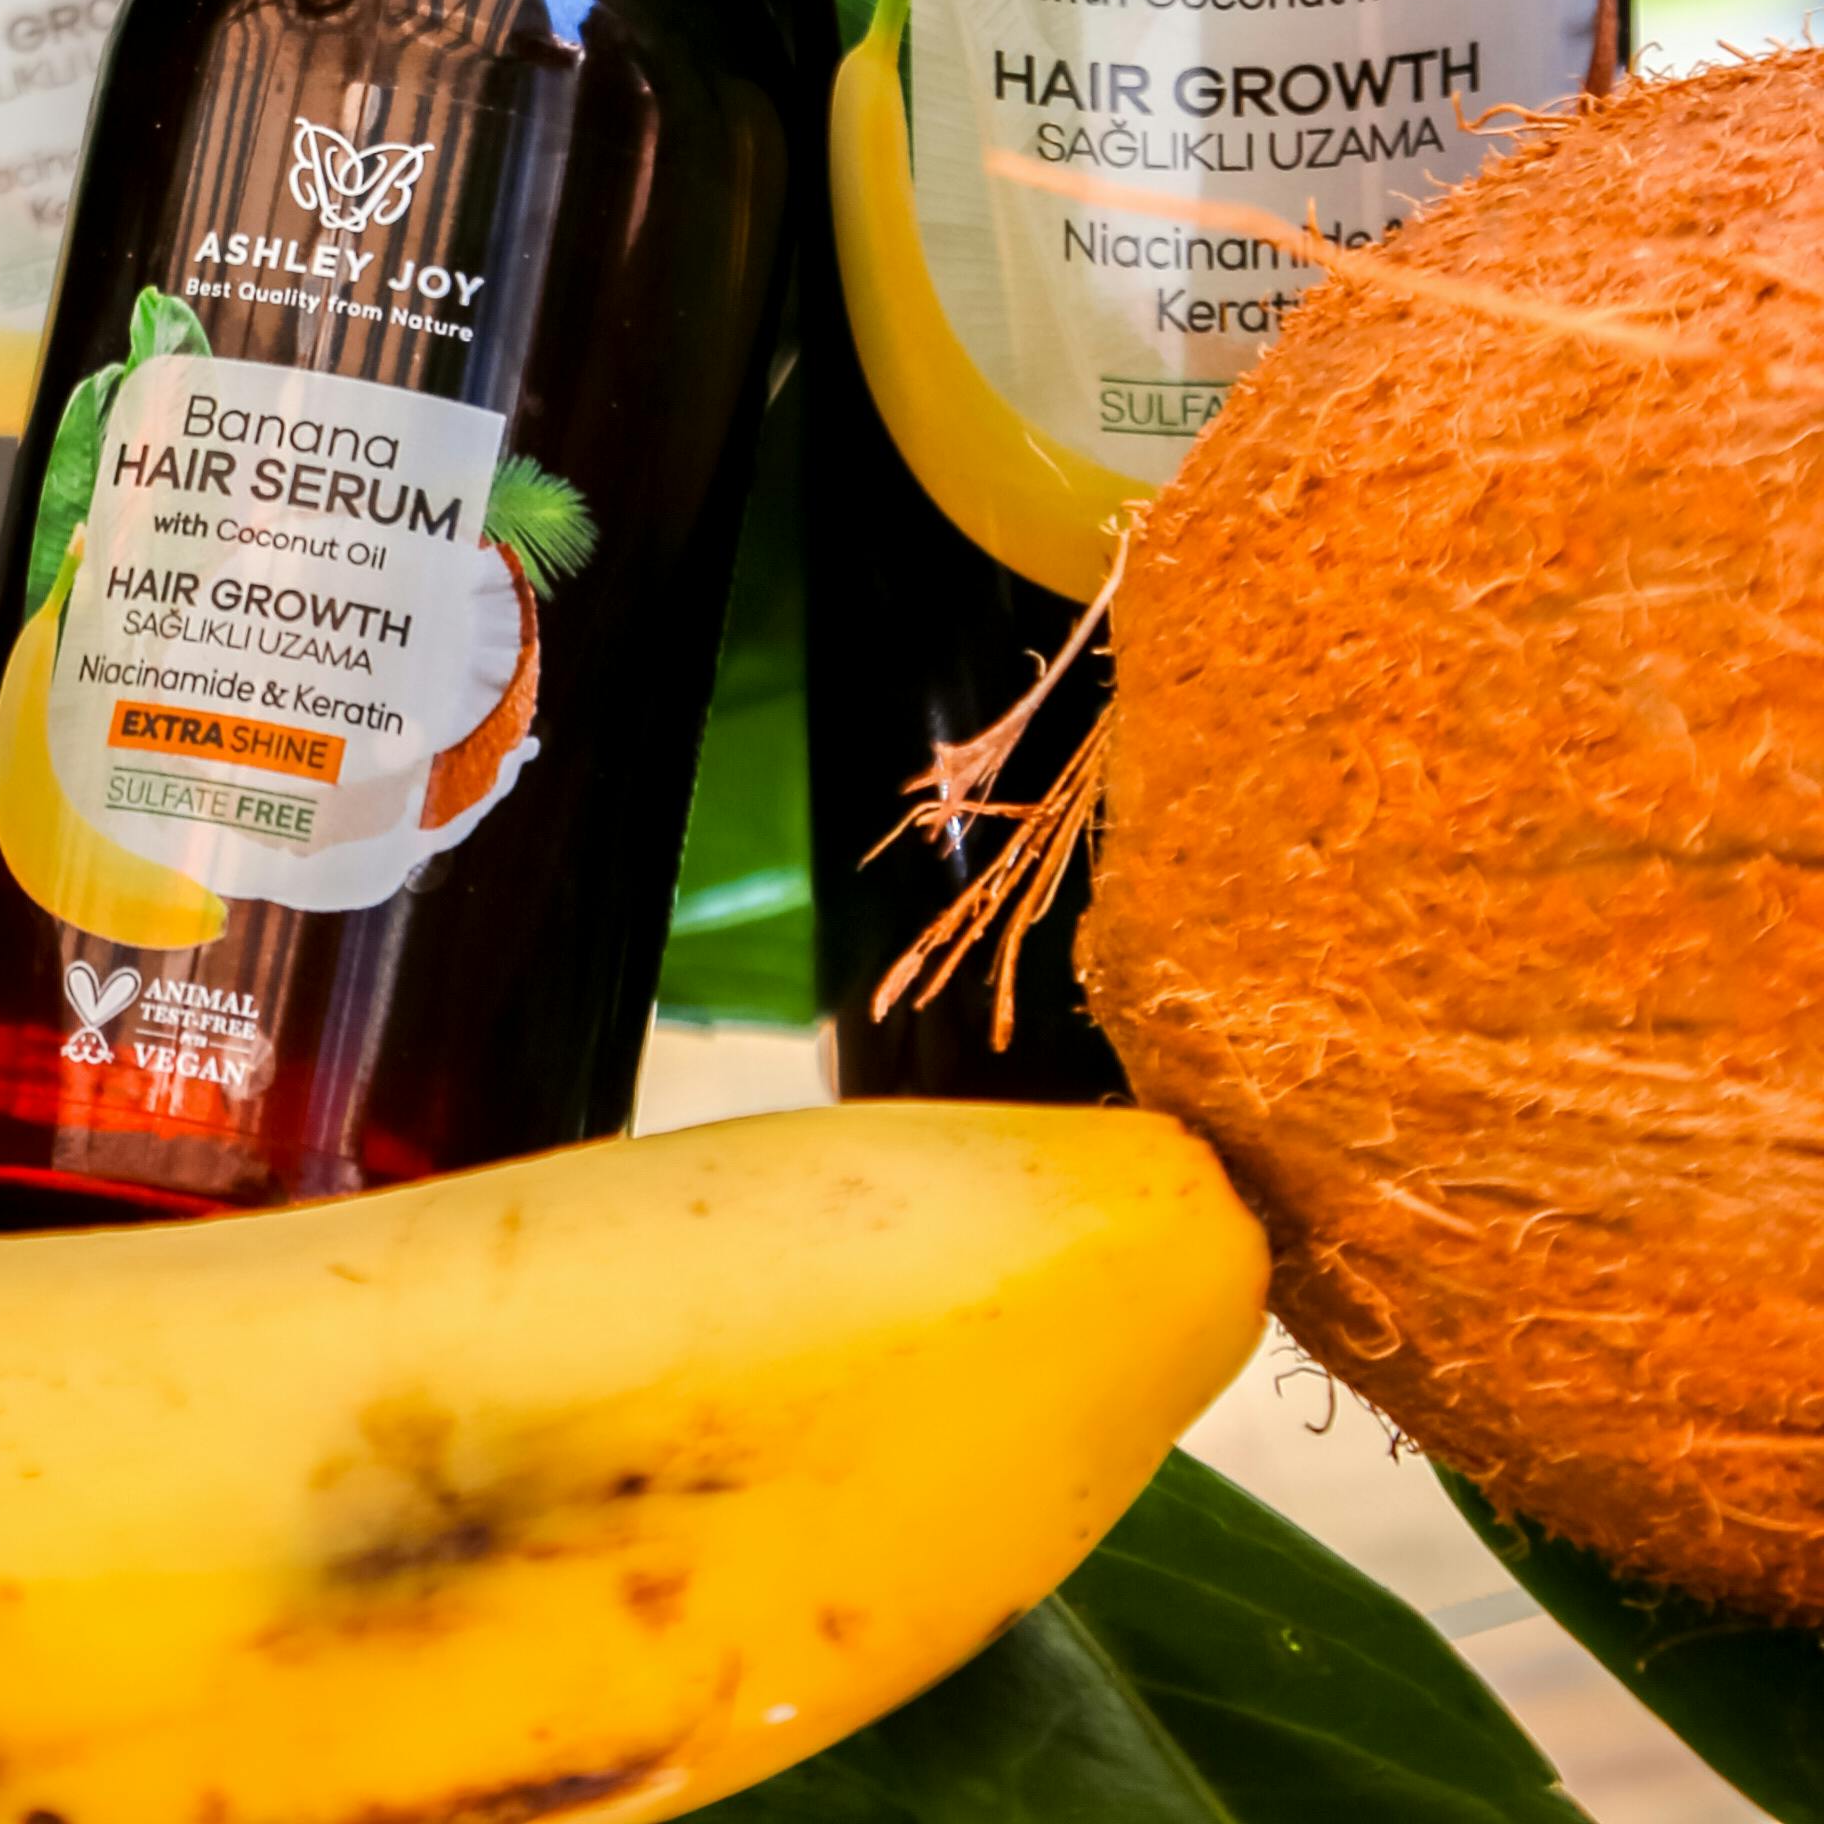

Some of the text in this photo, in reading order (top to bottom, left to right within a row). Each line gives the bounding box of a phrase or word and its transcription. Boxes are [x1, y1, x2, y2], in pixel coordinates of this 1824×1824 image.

[993, 43, 1482, 118] HAIR GROWTH
[1037, 116, 1446, 172] SAĞLIKLI UZAMA
[194, 232, 484, 307] ASHLEY JOY
[186, 278, 474, 343] Best Quality from Nature
[1156, 289, 1300, 333] Kerat
[183, 396, 399, 471] Banana
[1100, 390, 1224, 428] SULFA
[113, 443, 462, 541] HAIR SERUM
[154, 512, 386, 570] with Coconut Oil
[106, 566, 412, 647] HAIR GROWTH
[124, 606, 372, 675] SAĞLIKLI UZAMA
[79, 655, 403, 735] Niacinamide & Keratin
[122, 710, 328, 769] EXTRA SHINE
[107, 777, 315, 834] SULFATE FREE
[140, 1002, 256, 1040] TEST-FREE
[144, 977, 259, 1019] ANIMAL
[134, 1042, 255, 1086] VEGAN
